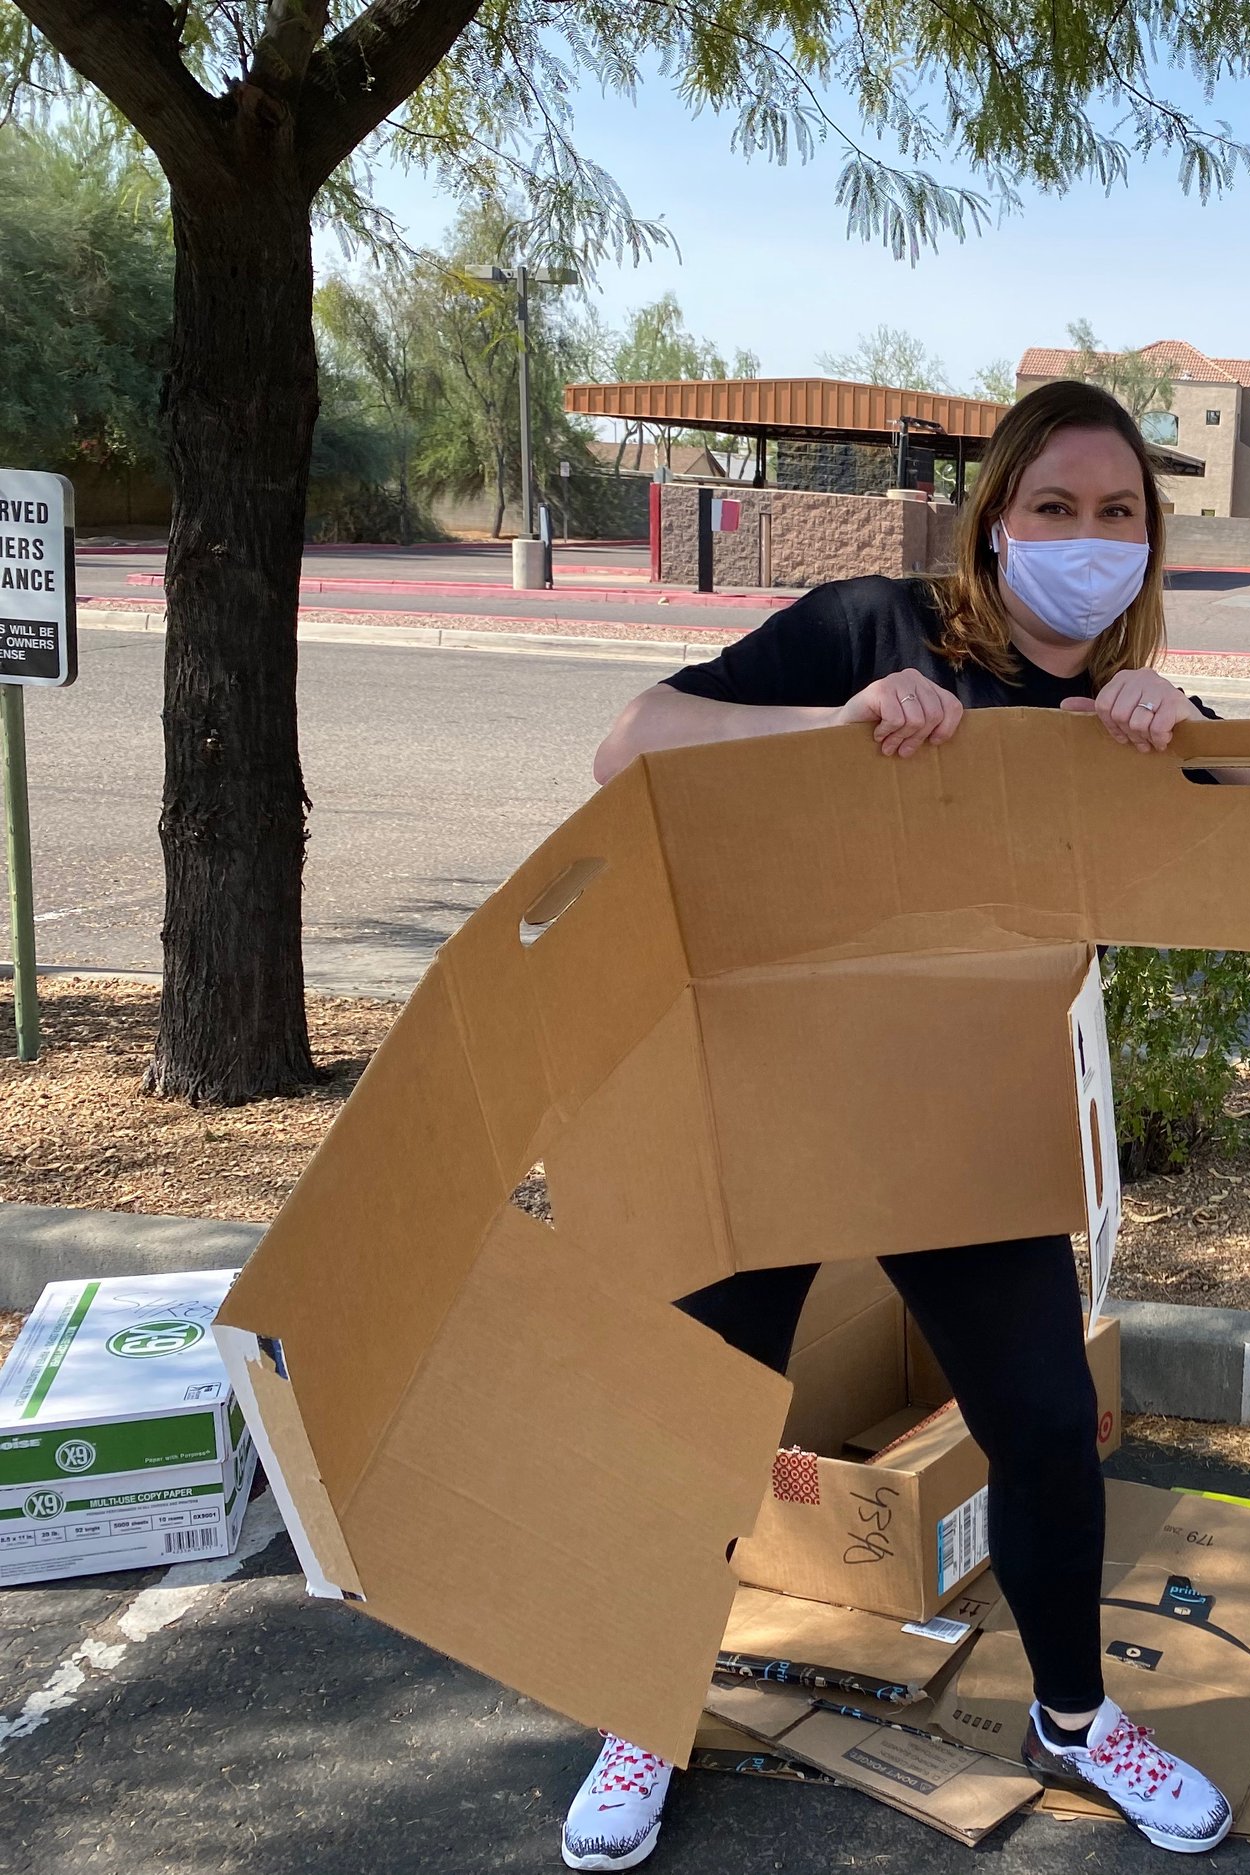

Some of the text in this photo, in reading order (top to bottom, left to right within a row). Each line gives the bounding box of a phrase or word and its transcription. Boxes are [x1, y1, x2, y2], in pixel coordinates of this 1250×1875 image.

[0, 500, 49, 524] RVED
[0, 536, 44, 560] ERS
[1, 567, 55, 592] ANCE
[10, 624, 36, 636] WILL
[39, 627, 55, 637] BE
[6, 636, 55, 650] OWNERS
[0, 648, 26, 660] ENSE
[89, 1488, 193, 1509] MULTI-USE COPY PAPER
[1186, 1530, 1214, 1547] 179
